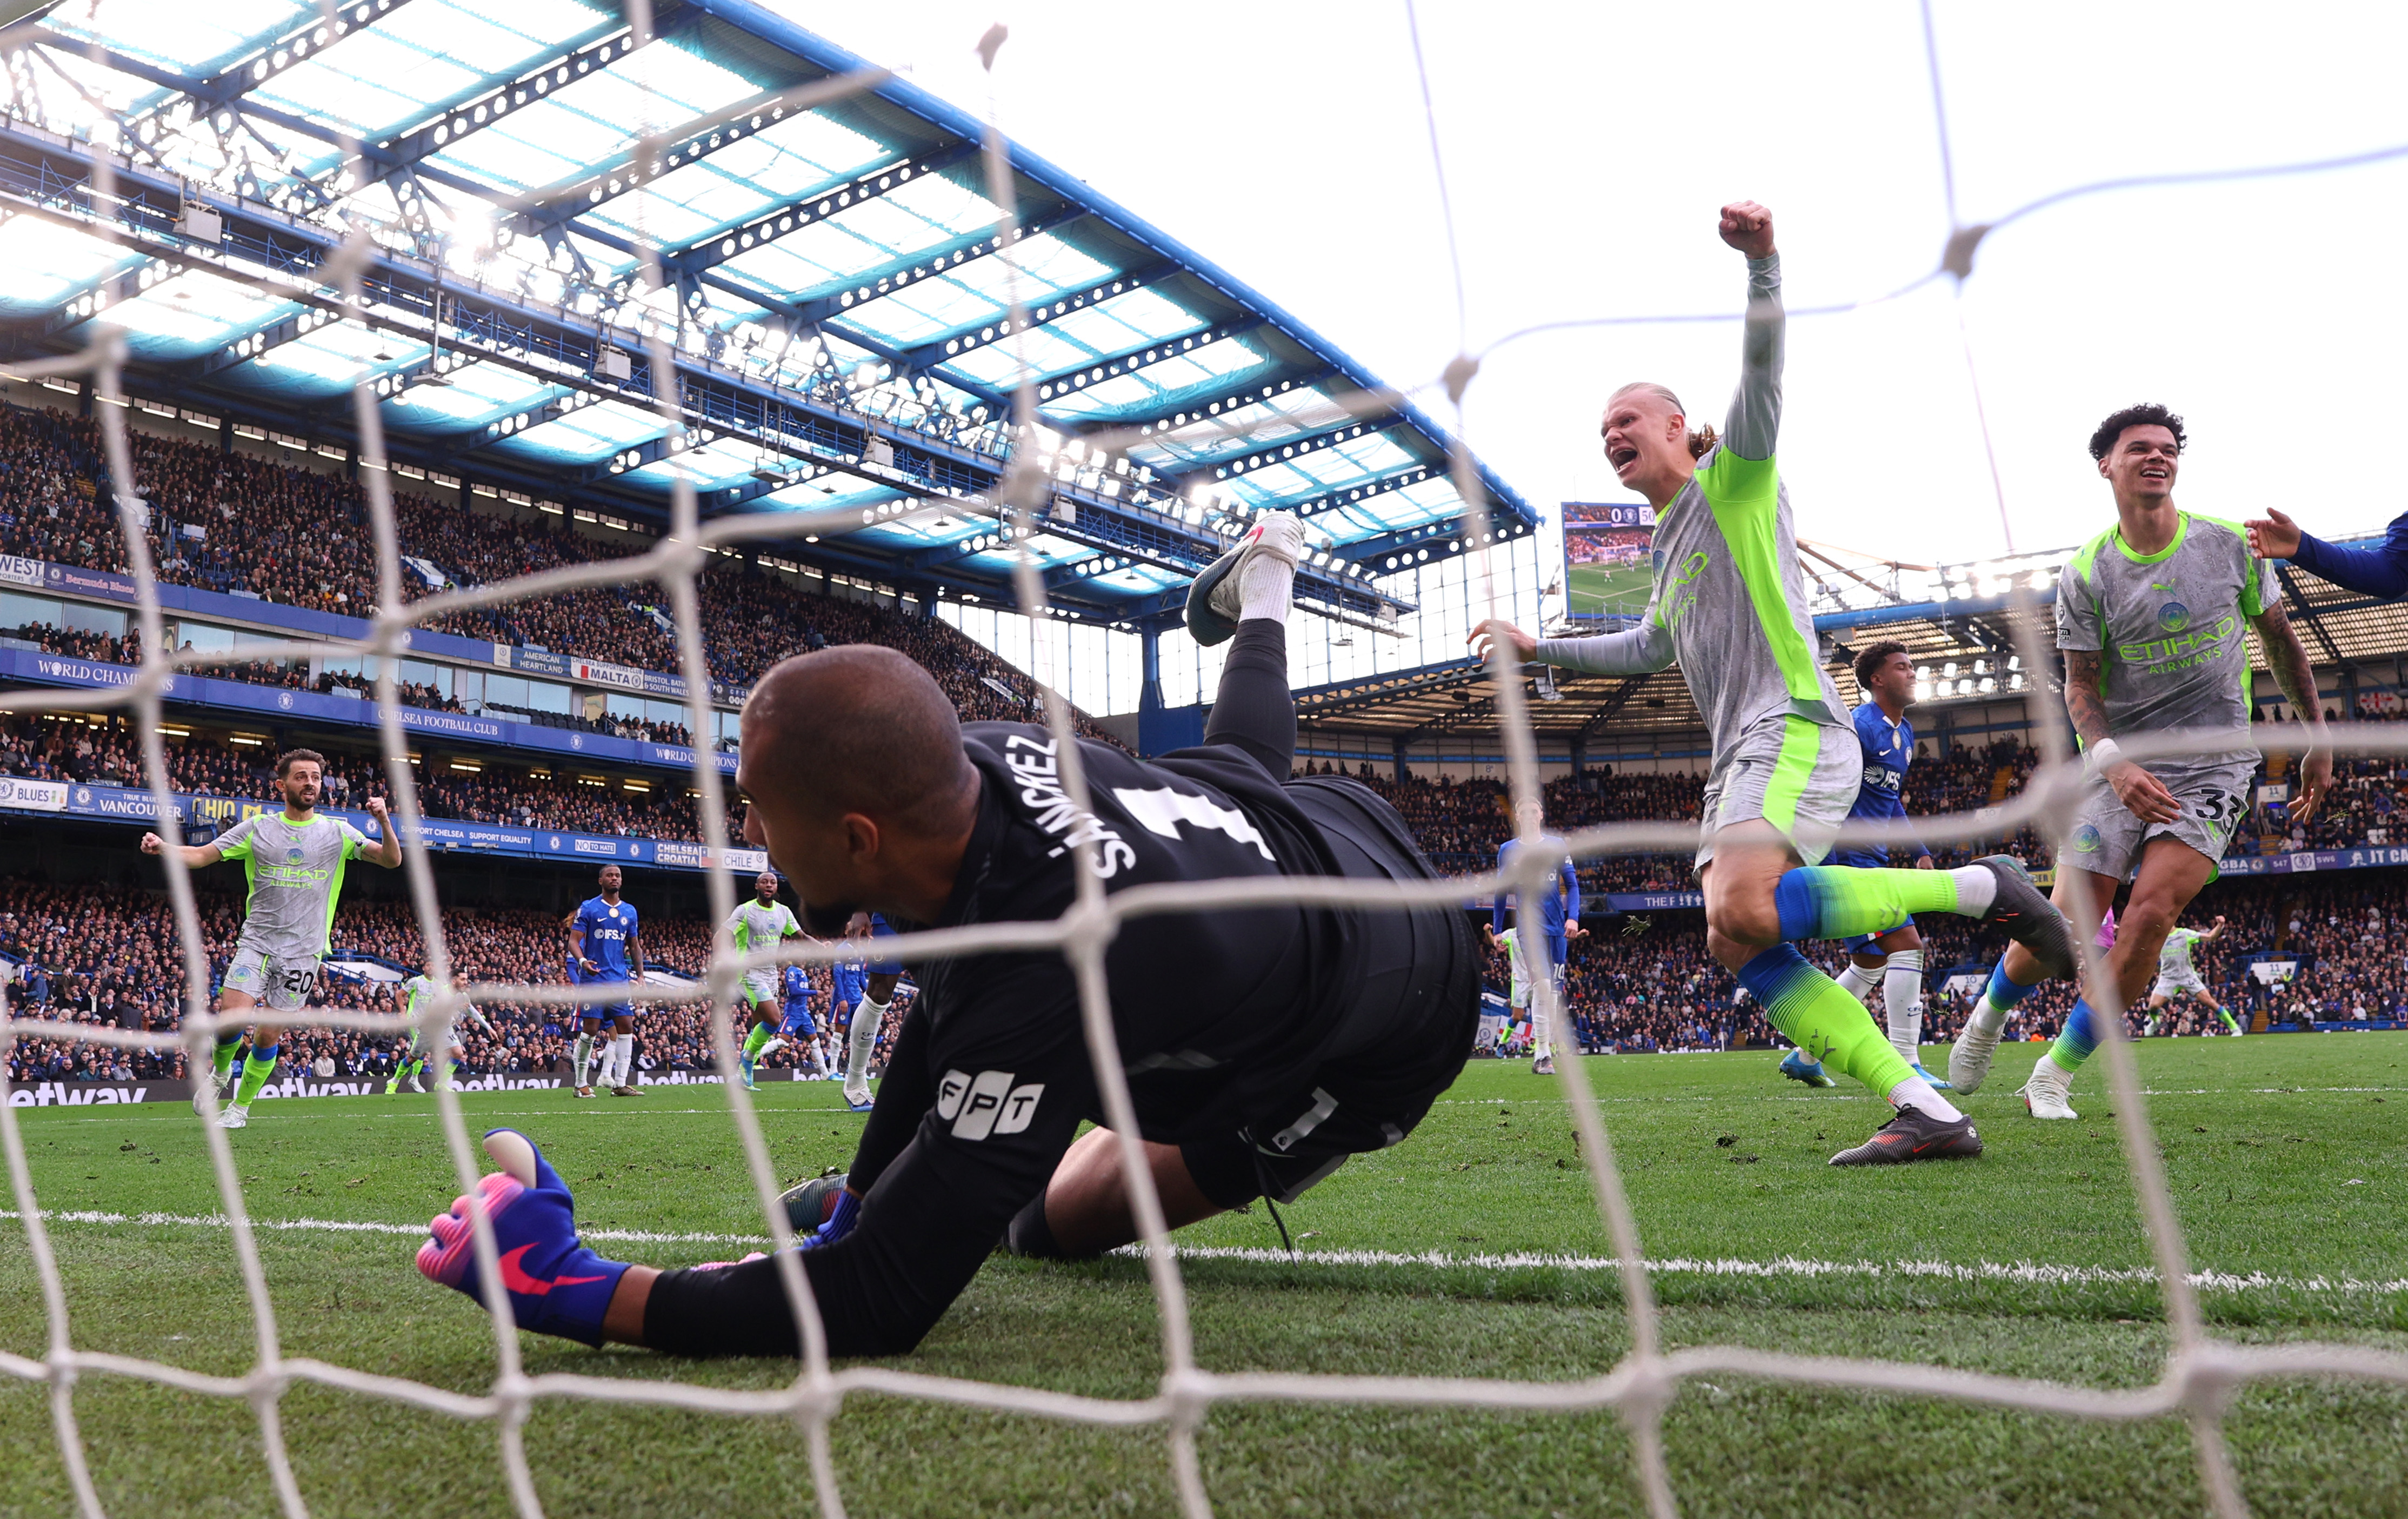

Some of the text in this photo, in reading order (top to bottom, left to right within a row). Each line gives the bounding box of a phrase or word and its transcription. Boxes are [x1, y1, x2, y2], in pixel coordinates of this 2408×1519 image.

[284, 451, 291, 461] 5
[1611, 508, 1655, 522] 0 50
[65, 573, 108, 590] Bermuda
[110, 581, 135, 594] Blues
[2119, 616, 2234, 660] ETIHAD
[523, 651, 560, 663] AMERICAN
[2149, 647, 2222, 674] AIRWAYS
[520, 660, 563, 674] HEARTLAND
[572, 658, 595, 666] CHELSEA
[596, 661, 629, 673] SUPPORTERS
[38, 660, 173, 691] WORLD CHAMNS
[591, 668, 630, 685] MALTA
[650, 684, 670, 693] SOUTH
[671, 687, 689, 697] WALES
[671, 679, 686, 688] BATH
[424, 716, 472, 732] FOOTBALL
[474, 722, 498, 735] CLUB
[656, 748, 737, 768] WORLD CHPIONS
[1880, 771, 1901, 791] IFS
[18, 788, 49, 802] BLUES
[99, 799, 182, 818] VANCOUVER
[2196, 788, 2241, 835] 33
[1112, 786, 1277, 862] 1
[434, 828, 464, 838] CHELSEA
[469, 832, 500, 841] SUPPORT
[501, 834, 531, 844] EQUALITY
[576, 841, 589, 850] NO
[657, 844, 699, 856] CHELSEA
[657, 853, 697, 865] CROATIA
[724, 855, 752, 868] CHILE
[2316, 855, 2336, 864] SW6
[258, 865, 329, 880] ETIHAD
[270, 880, 313, 889] AIRWAYS
[1644, 896, 1675, 907] THE F
[1553, 963, 1565, 980] 10
[2270, 963, 2280, 972] 11
[284, 970, 314, 994] 20
[1965, 975, 1977, 983] 10
[2, 1082, 147, 1107] etway
[940, 1079, 1036, 1122] FPT
[1272, 1086, 1339, 1152] 1
